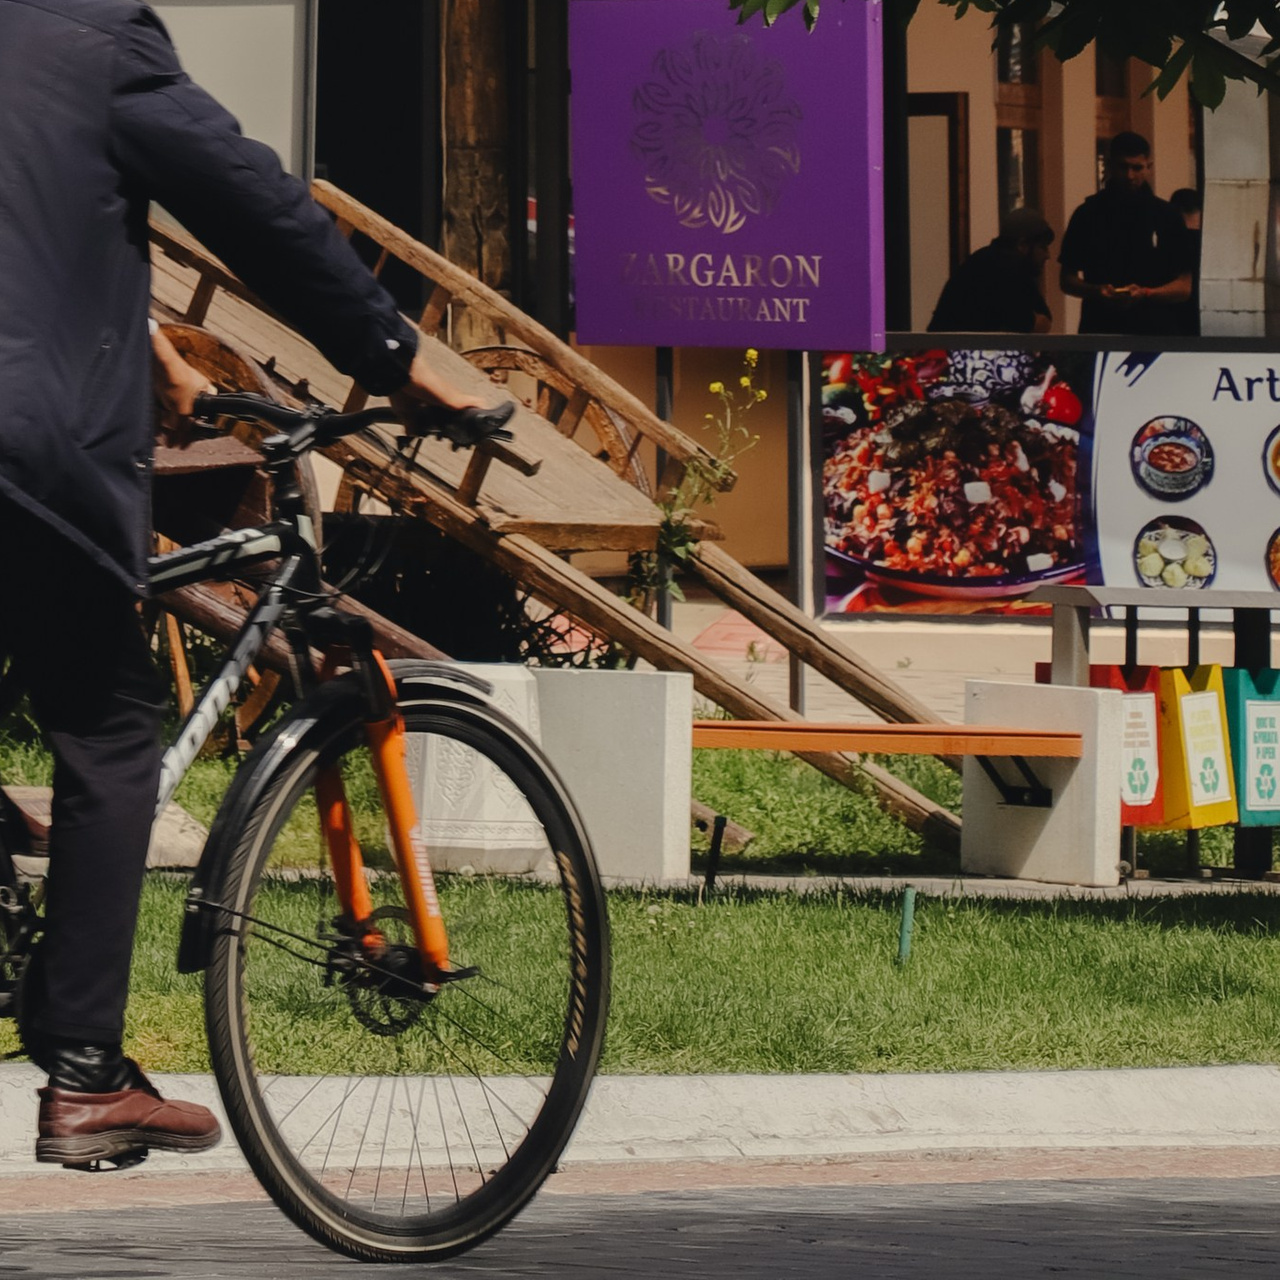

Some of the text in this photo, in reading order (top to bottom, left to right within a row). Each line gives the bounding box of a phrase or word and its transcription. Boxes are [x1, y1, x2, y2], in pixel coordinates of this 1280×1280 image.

[622, 254, 822, 288] ZARGARON
[636, 297, 810, 322] RESTAURANT
[1212, 367, 1280, 402] Art
